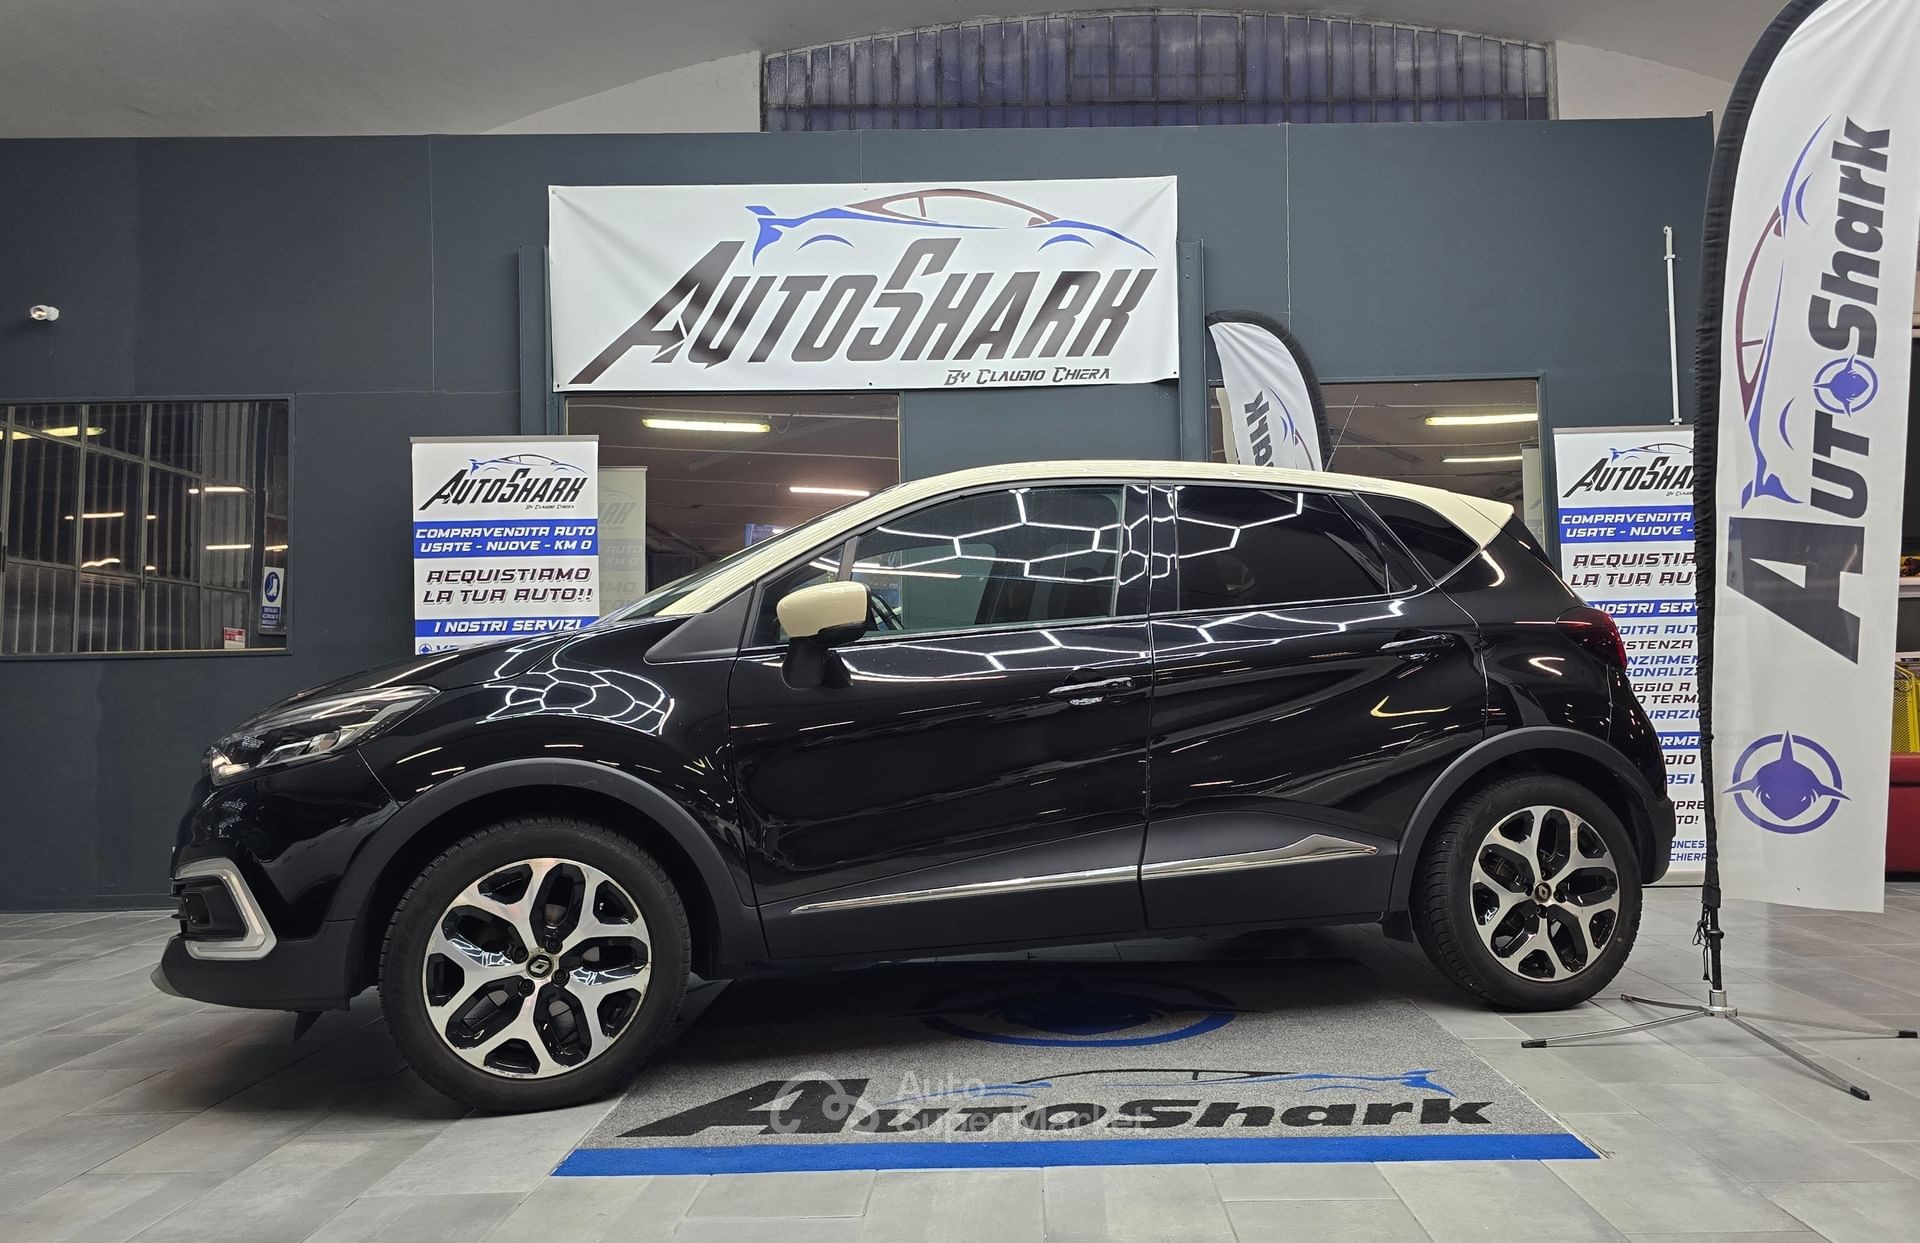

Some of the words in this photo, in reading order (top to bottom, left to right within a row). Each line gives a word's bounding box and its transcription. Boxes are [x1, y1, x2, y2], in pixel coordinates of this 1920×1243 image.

[1561, 512, 1691, 525] COMPRAVENDITA
[416, 526, 550, 539] COMPRAVENDITA
[554, 526, 596, 537] AUTO
[1566, 527, 1616, 538] USATE
[1630, 526, 1683, 536] NUOVE
[420, 542, 472, 553] USATE
[486, 541, 541, 552] NUOVE
[554, 540, 575, 550] KM
[1573, 552, 1696, 568] ACQUISTIA
[426, 568, 591, 584] ACQUISTIAMO
[1570, 572, 1600, 586] LA
[1606, 572, 1653, 586] TUA
[1659, 571, 1696, 586] AU
[423, 590, 454, 603] LA
[460, 588, 506, 602] TUA
[514, 588, 593, 602] AUTO!!
[434, 622, 441, 633] I
[445, 620, 508, 633] NOSTRI
[511, 619, 582, 632] SERVIZI
[1618, 625, 1658, 635] DITA
[1631, 682, 1673, 692] GGIO
[1679, 682, 1691, 692] A
[1652, 694, 1699, 704] TERM
[1665, 755, 1696, 765] DIO
[1676, 815, 1699, 824] TO!
